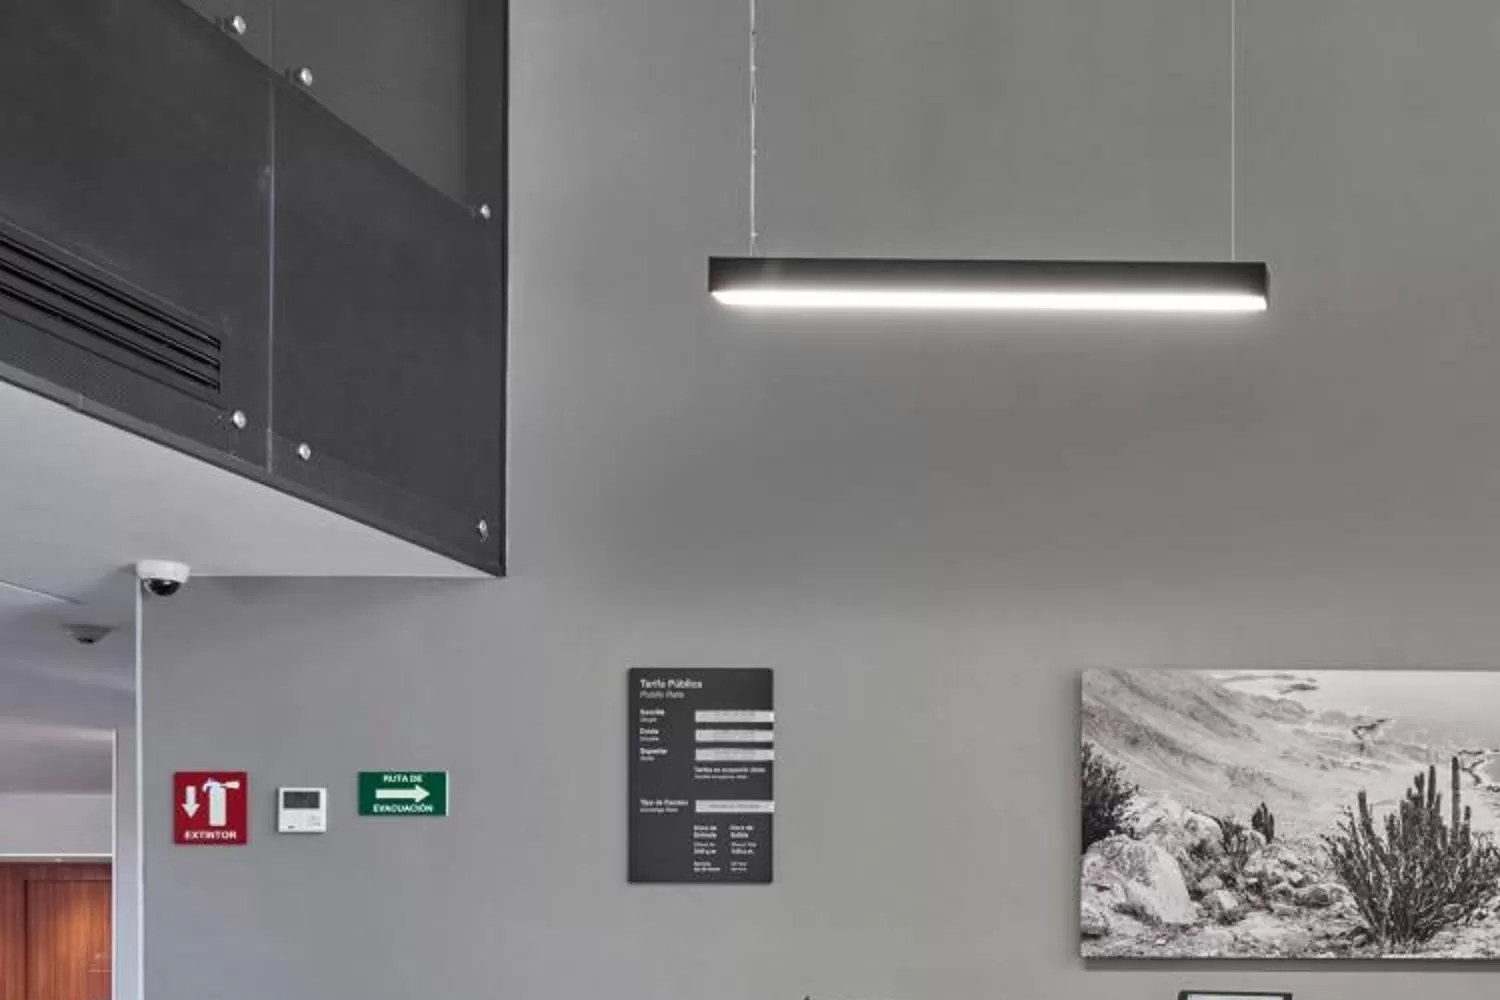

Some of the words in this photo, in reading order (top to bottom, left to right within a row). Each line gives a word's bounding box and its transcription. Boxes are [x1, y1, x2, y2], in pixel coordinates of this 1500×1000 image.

[383, 774, 408, 783] RUTA
[410, 774, 423, 783] DE
[372, 802, 433, 813] EVACUACIÓN
[184, 830, 237, 841] EXTINTOR
